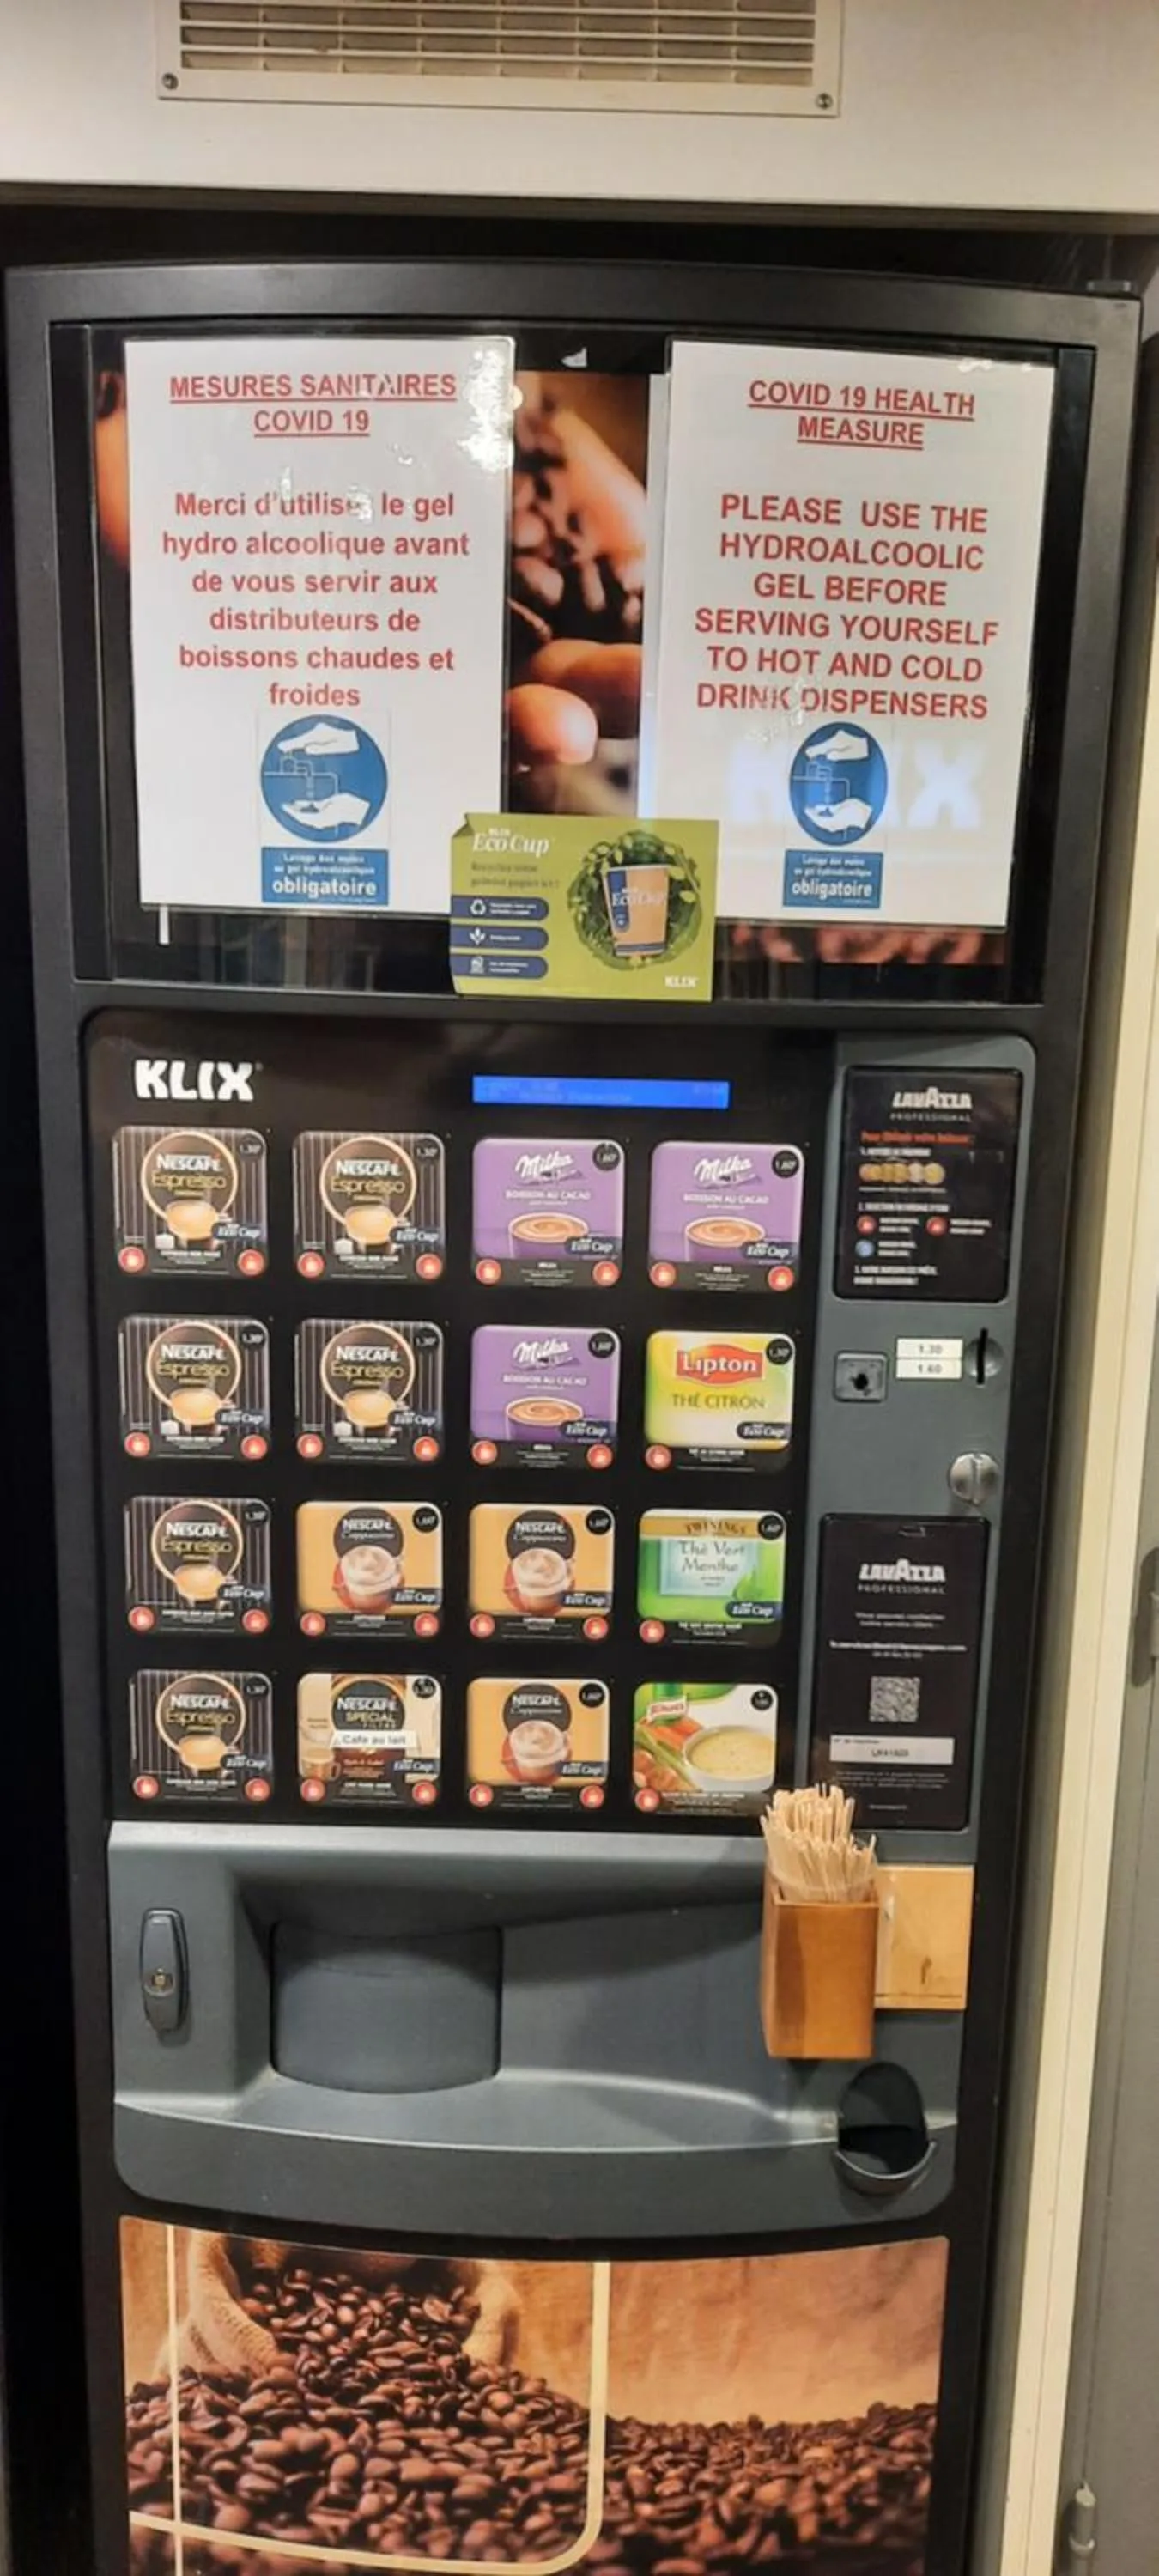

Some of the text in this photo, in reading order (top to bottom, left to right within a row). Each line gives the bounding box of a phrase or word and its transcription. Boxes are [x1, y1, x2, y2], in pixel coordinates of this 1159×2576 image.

[170, 374, 456, 398] MESURES SANITAIRES
[749, 380, 975, 416] COVID 19 HEALTH
[254, 410, 369, 433] COVID 19
[798, 416, 924, 446] MEASURE
[175, 493, 246, 517] Merci
[382, 493, 404, 517] le
[414, 494, 454, 523] gel
[720, 494, 988, 533] PLEASE USE THE
[163, 532, 469, 560] hydro alcoolique avant
[719, 533, 985, 571] HYDROALCOOLIC
[191, 570, 438, 593] de vous servir aux
[754, 573, 947, 606] GEL BEFORE
[209, 609, 420, 631] distributeurs de
[695, 607, 999, 647] SERVING YOURSELF
[179, 646, 455, 671] boissons chaudes et
[707, 646, 983, 683] TO HOT AND COLD
[270, 683, 361, 707] froides
[696, 683, 988, 719] DRINK DISPENSERS
[272, 876, 377, 898] obligatoire
[792, 878, 872, 900] obligatoire
[135, 1060, 253, 1101] KLIX
[515, 1151, 573, 1178] Milka
[694, 1155, 752, 1182] Milka
[152, 1170, 227, 1190] Espresso
[331, 1177, 405, 1196] Espresso
[513, 1338, 570, 1363] Milka
[158, 1361, 229, 1379] Espresso
[331, 1361, 404, 1381] Espresso
[683, 1353, 756, 1376] Lipton
[672, 1392, 765, 1409] THÉ CITRON
[161, 1538, 232, 1557] Espresso
[679, 1540, 745, 1556] Thé Vert
[682, 1557, 738, 1572] Menthe
[859, 1558, 946, 1582] LAVAZZA
[166, 1710, 235, 1726] Espresso
